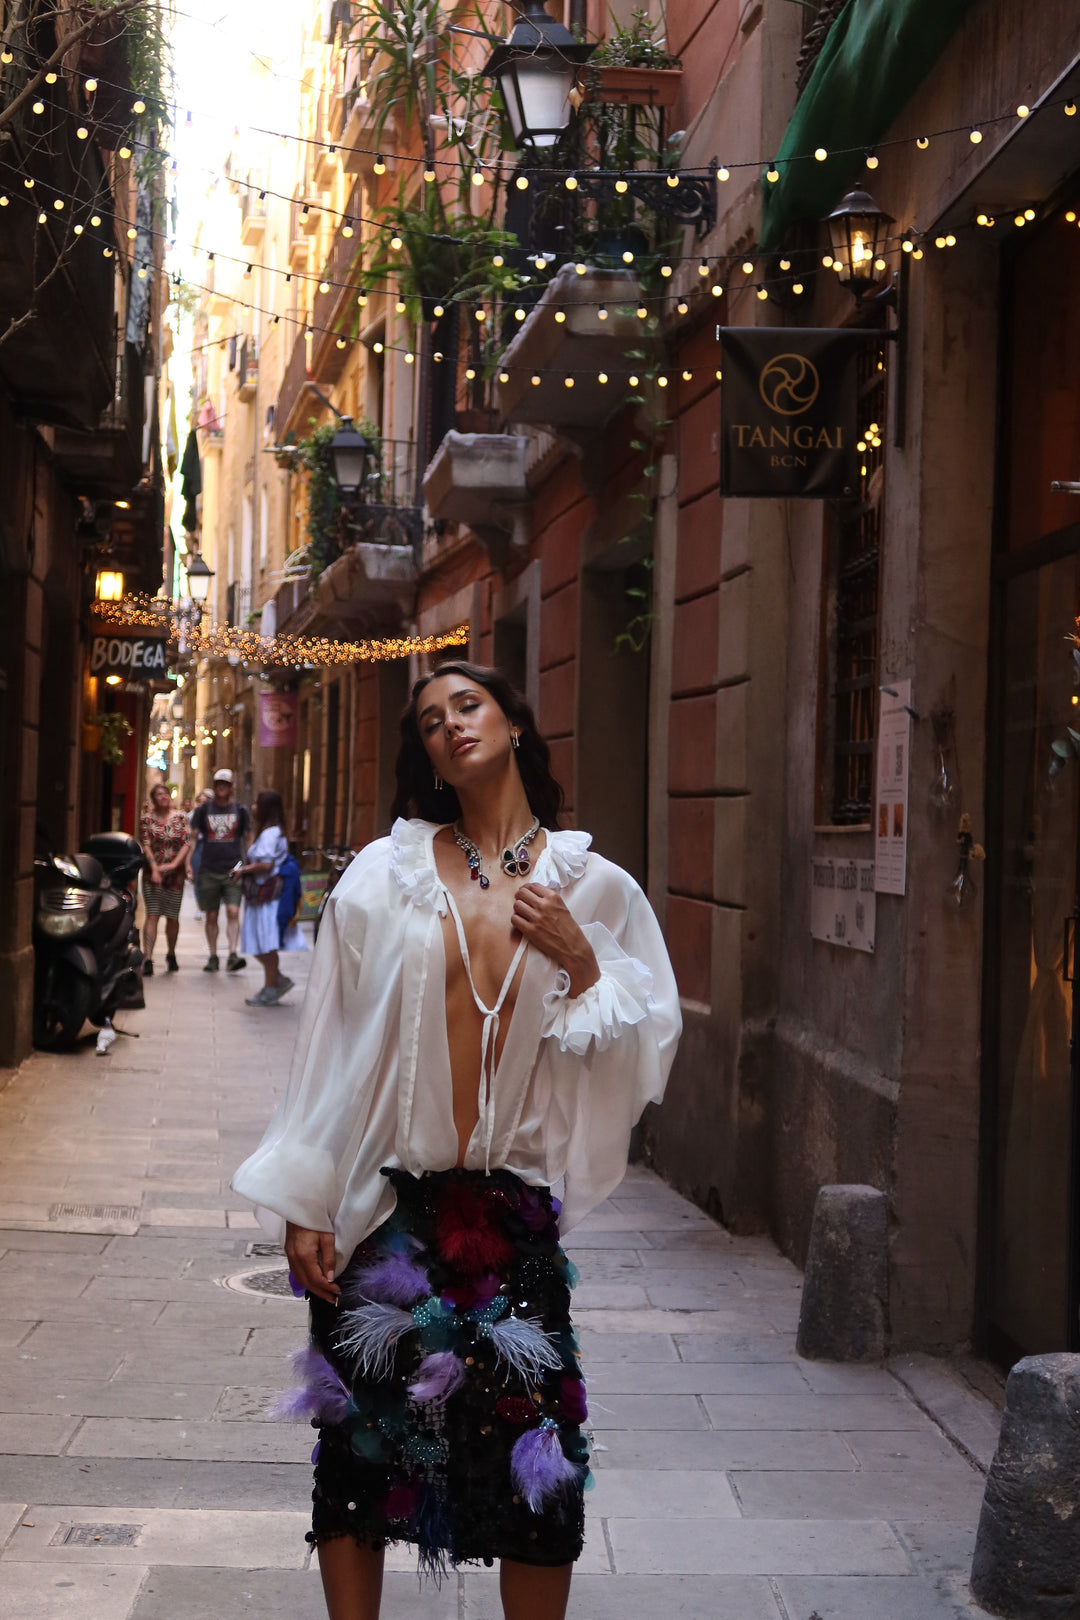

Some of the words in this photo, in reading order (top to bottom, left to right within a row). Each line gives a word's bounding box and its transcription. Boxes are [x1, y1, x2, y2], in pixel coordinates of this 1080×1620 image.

[732, 425, 843, 448] TANGAI
[771, 456, 806, 467] BCN
[92, 638, 165, 670] BODEGA
